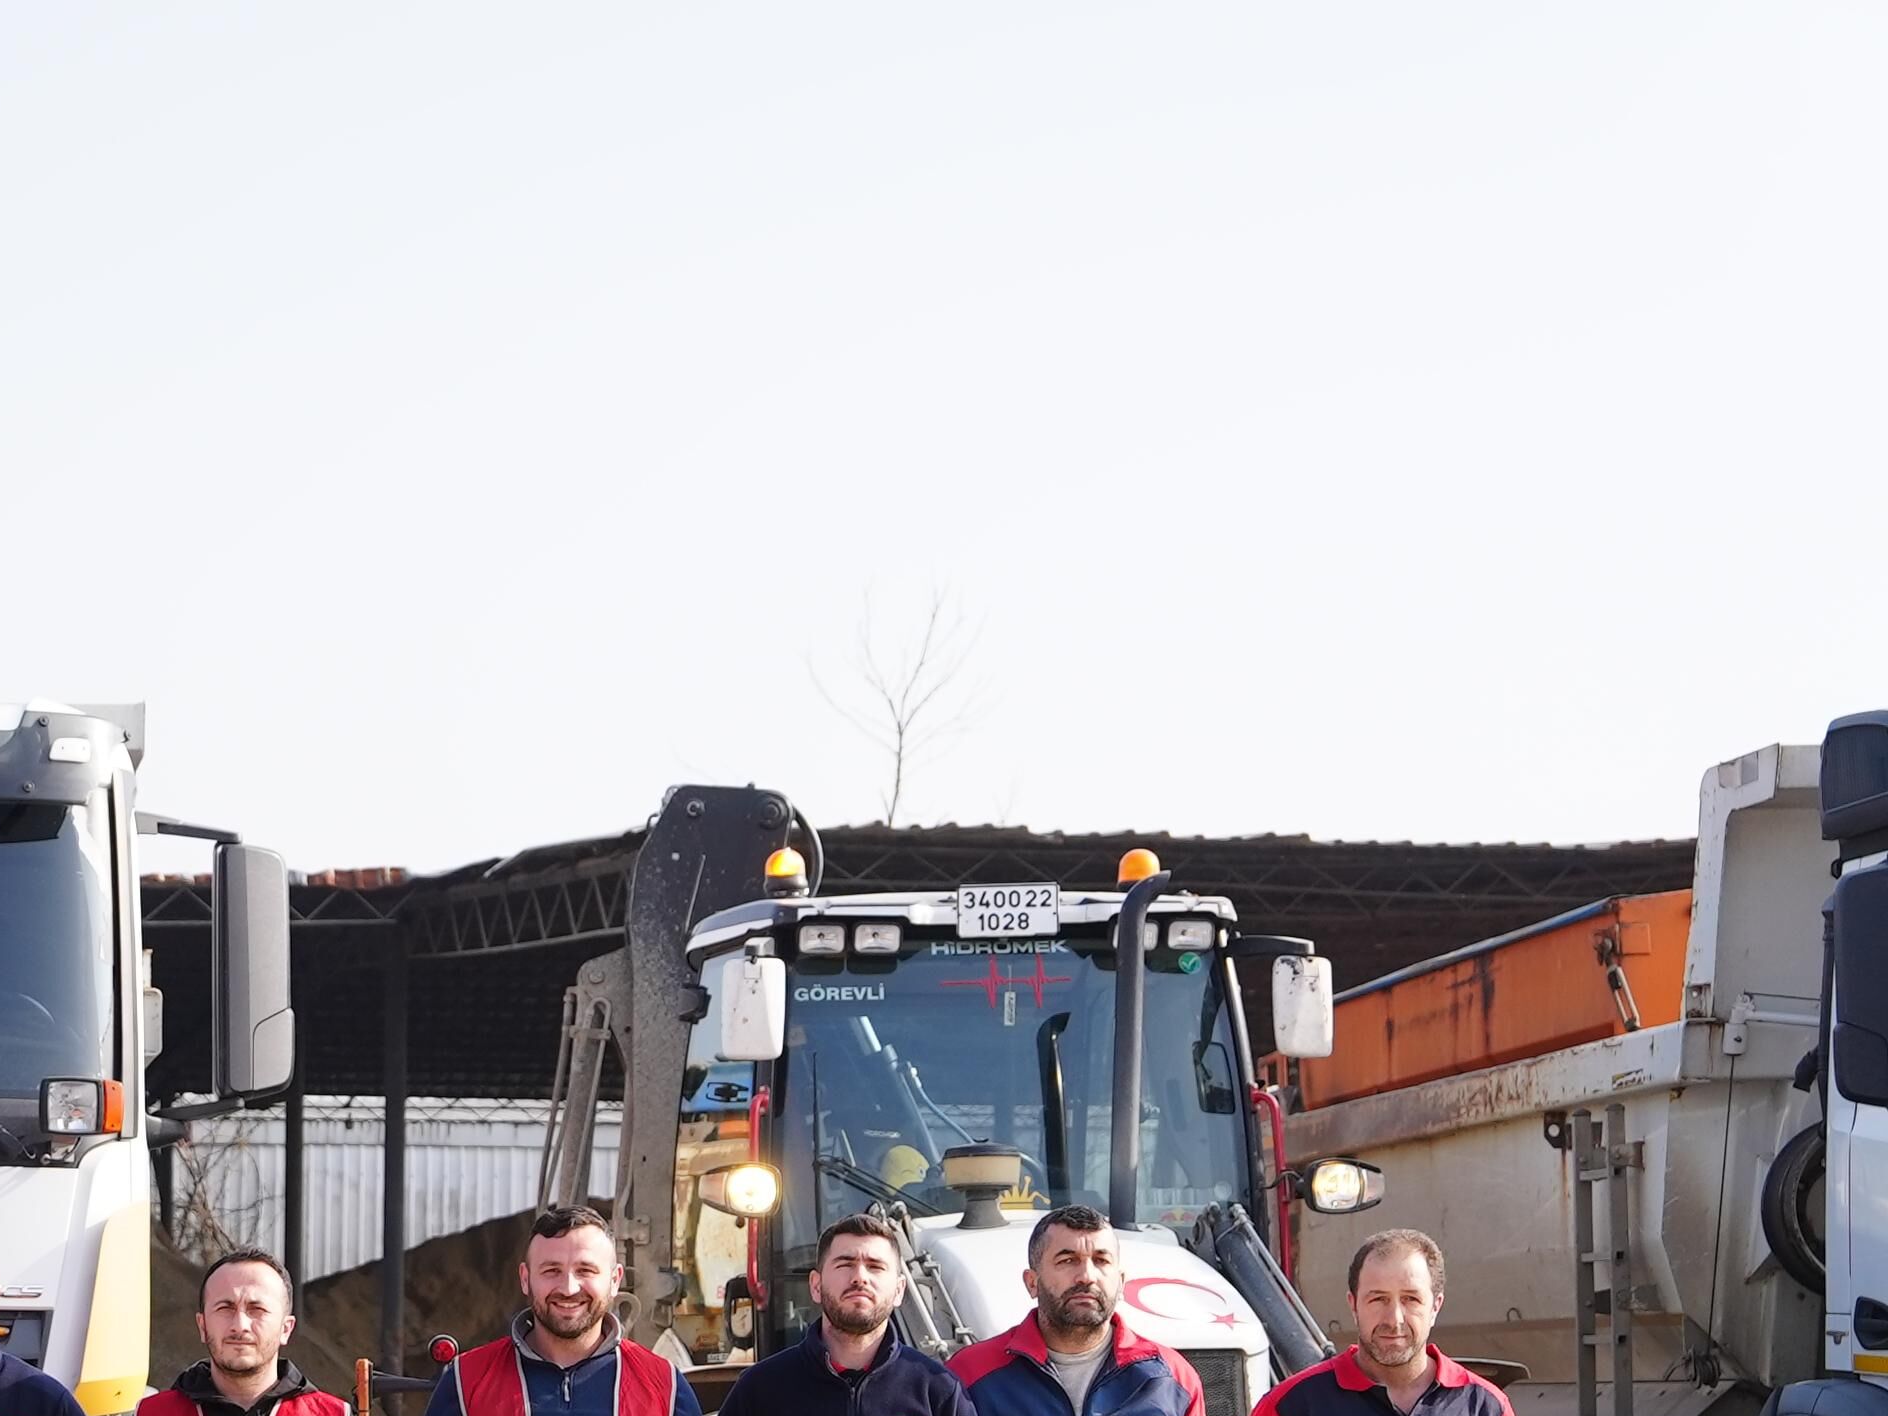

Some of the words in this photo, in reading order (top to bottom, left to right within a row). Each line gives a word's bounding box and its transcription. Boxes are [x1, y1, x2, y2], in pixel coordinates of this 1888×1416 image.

[963, 889, 1053, 909] 340022
[978, 912, 1031, 932] 1028
[793, 982, 885, 1002] GÖREVLİ
